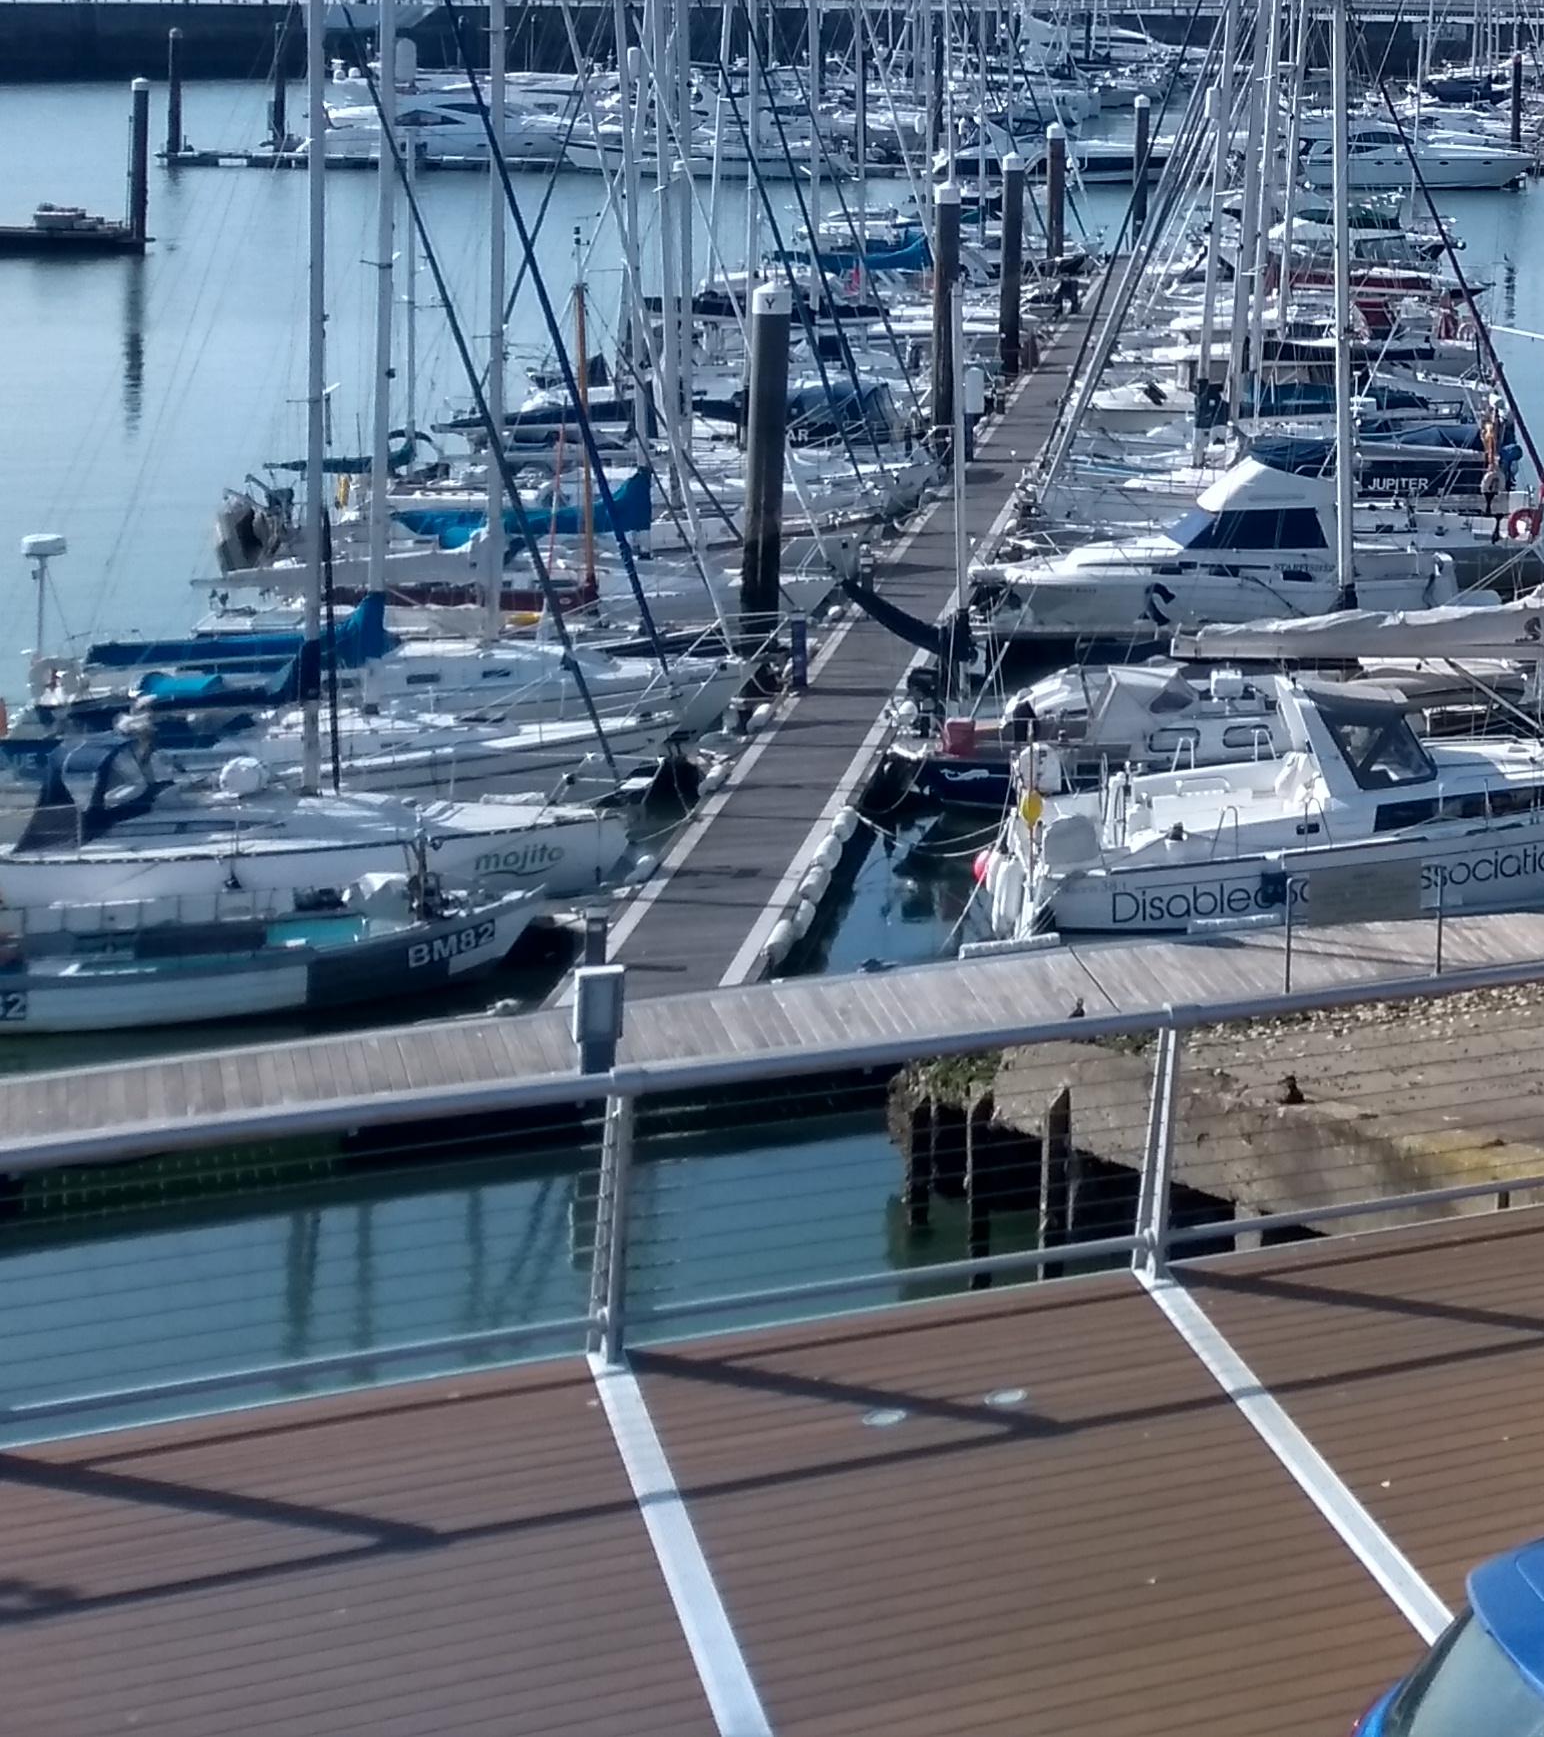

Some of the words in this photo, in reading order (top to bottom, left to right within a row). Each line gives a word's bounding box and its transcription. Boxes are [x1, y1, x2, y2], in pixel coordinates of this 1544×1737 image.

[1368, 477, 1428, 490] JUPITER
[475, 844, 565, 871] mojito
[408, 923, 495, 968] BM82
